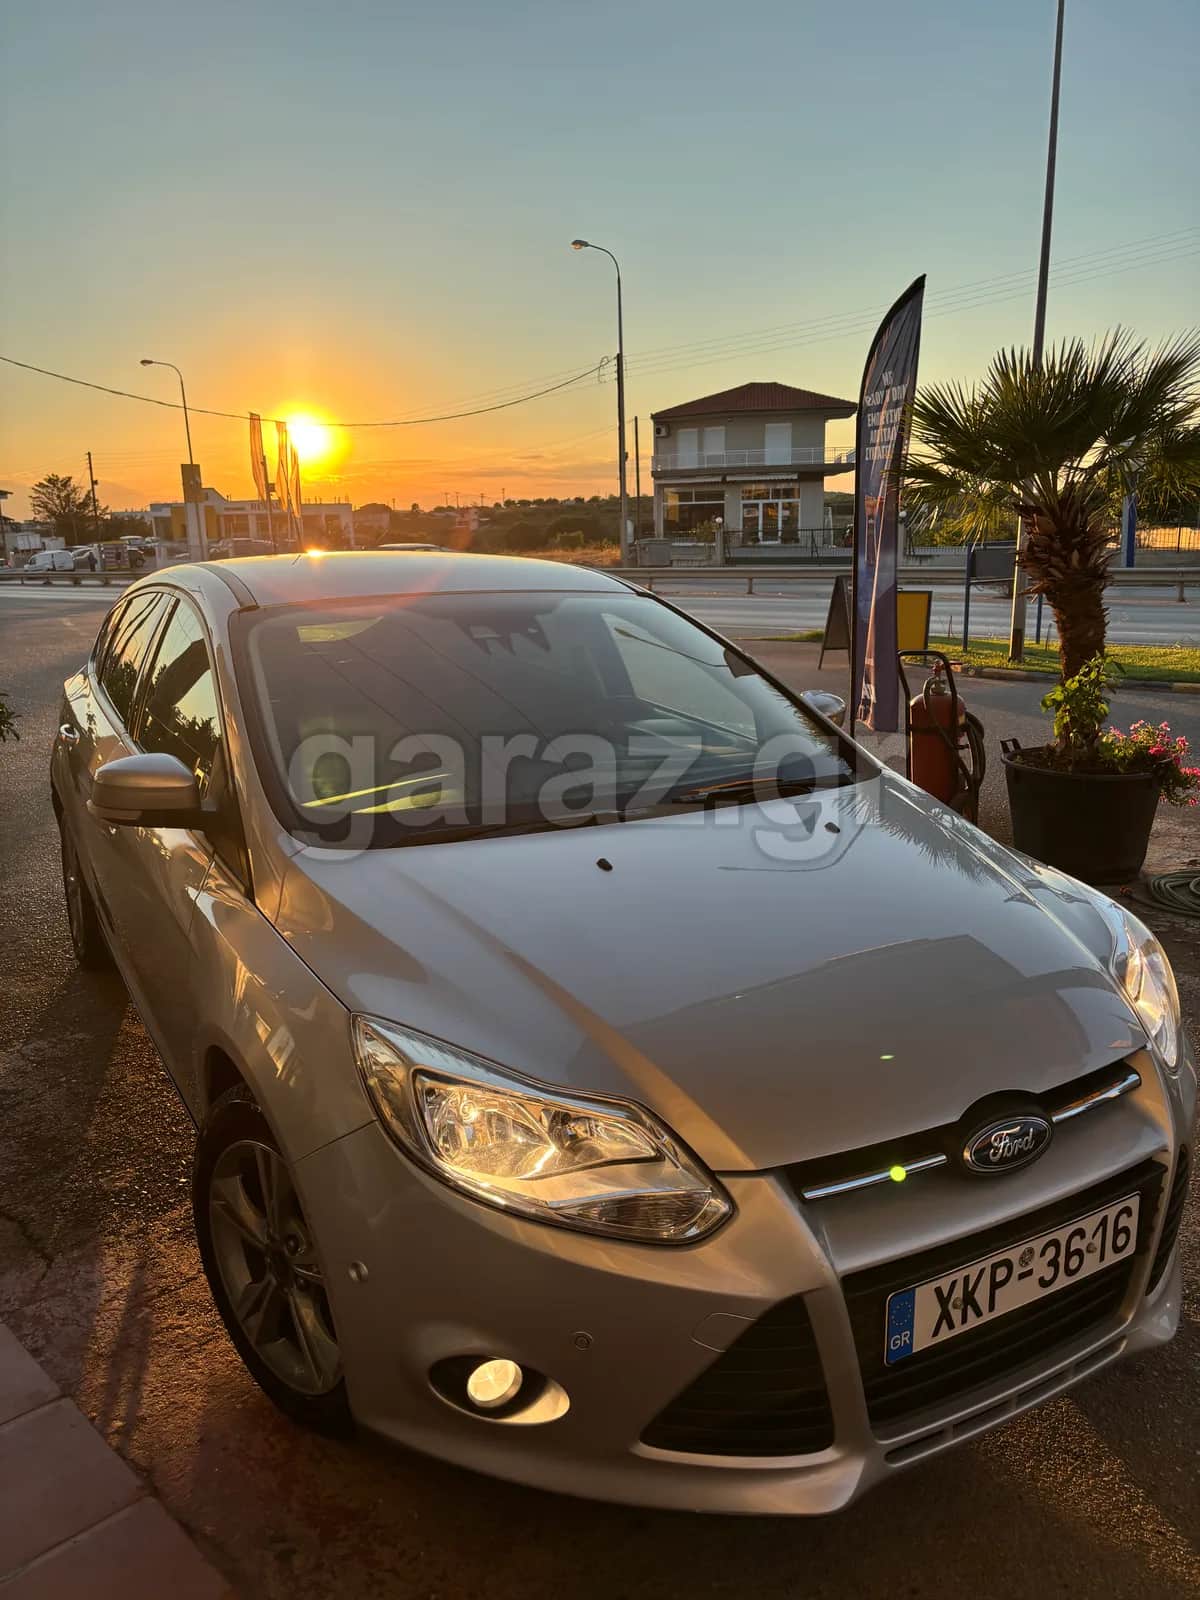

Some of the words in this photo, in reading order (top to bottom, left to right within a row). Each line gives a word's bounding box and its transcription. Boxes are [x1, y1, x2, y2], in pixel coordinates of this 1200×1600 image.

[989, 1126, 1034, 1161] Ford
[931, 1205, 1133, 1338] XKP-3616
[890, 1331, 911, 1351] GR
